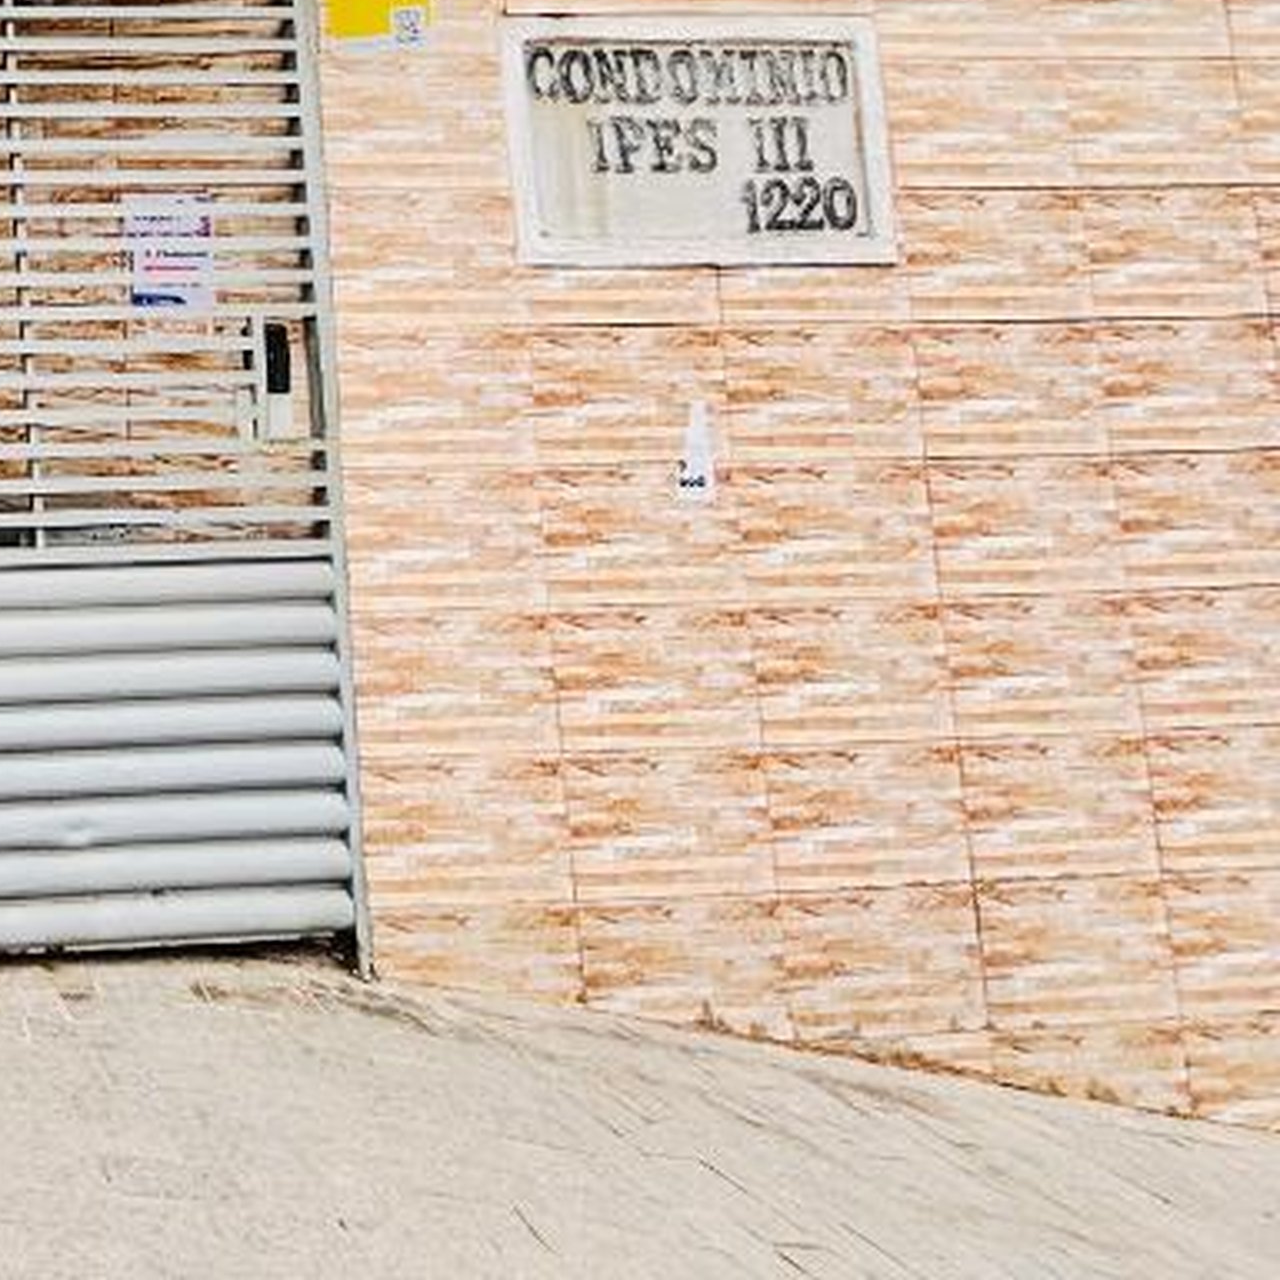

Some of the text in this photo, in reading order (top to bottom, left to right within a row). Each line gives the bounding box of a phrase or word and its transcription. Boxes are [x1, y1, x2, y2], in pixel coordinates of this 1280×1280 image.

[526, 46, 850, 107] CONDOMINIO
[587, 115, 816, 175] IPES III
[739, 176, 860, 235] 1220
